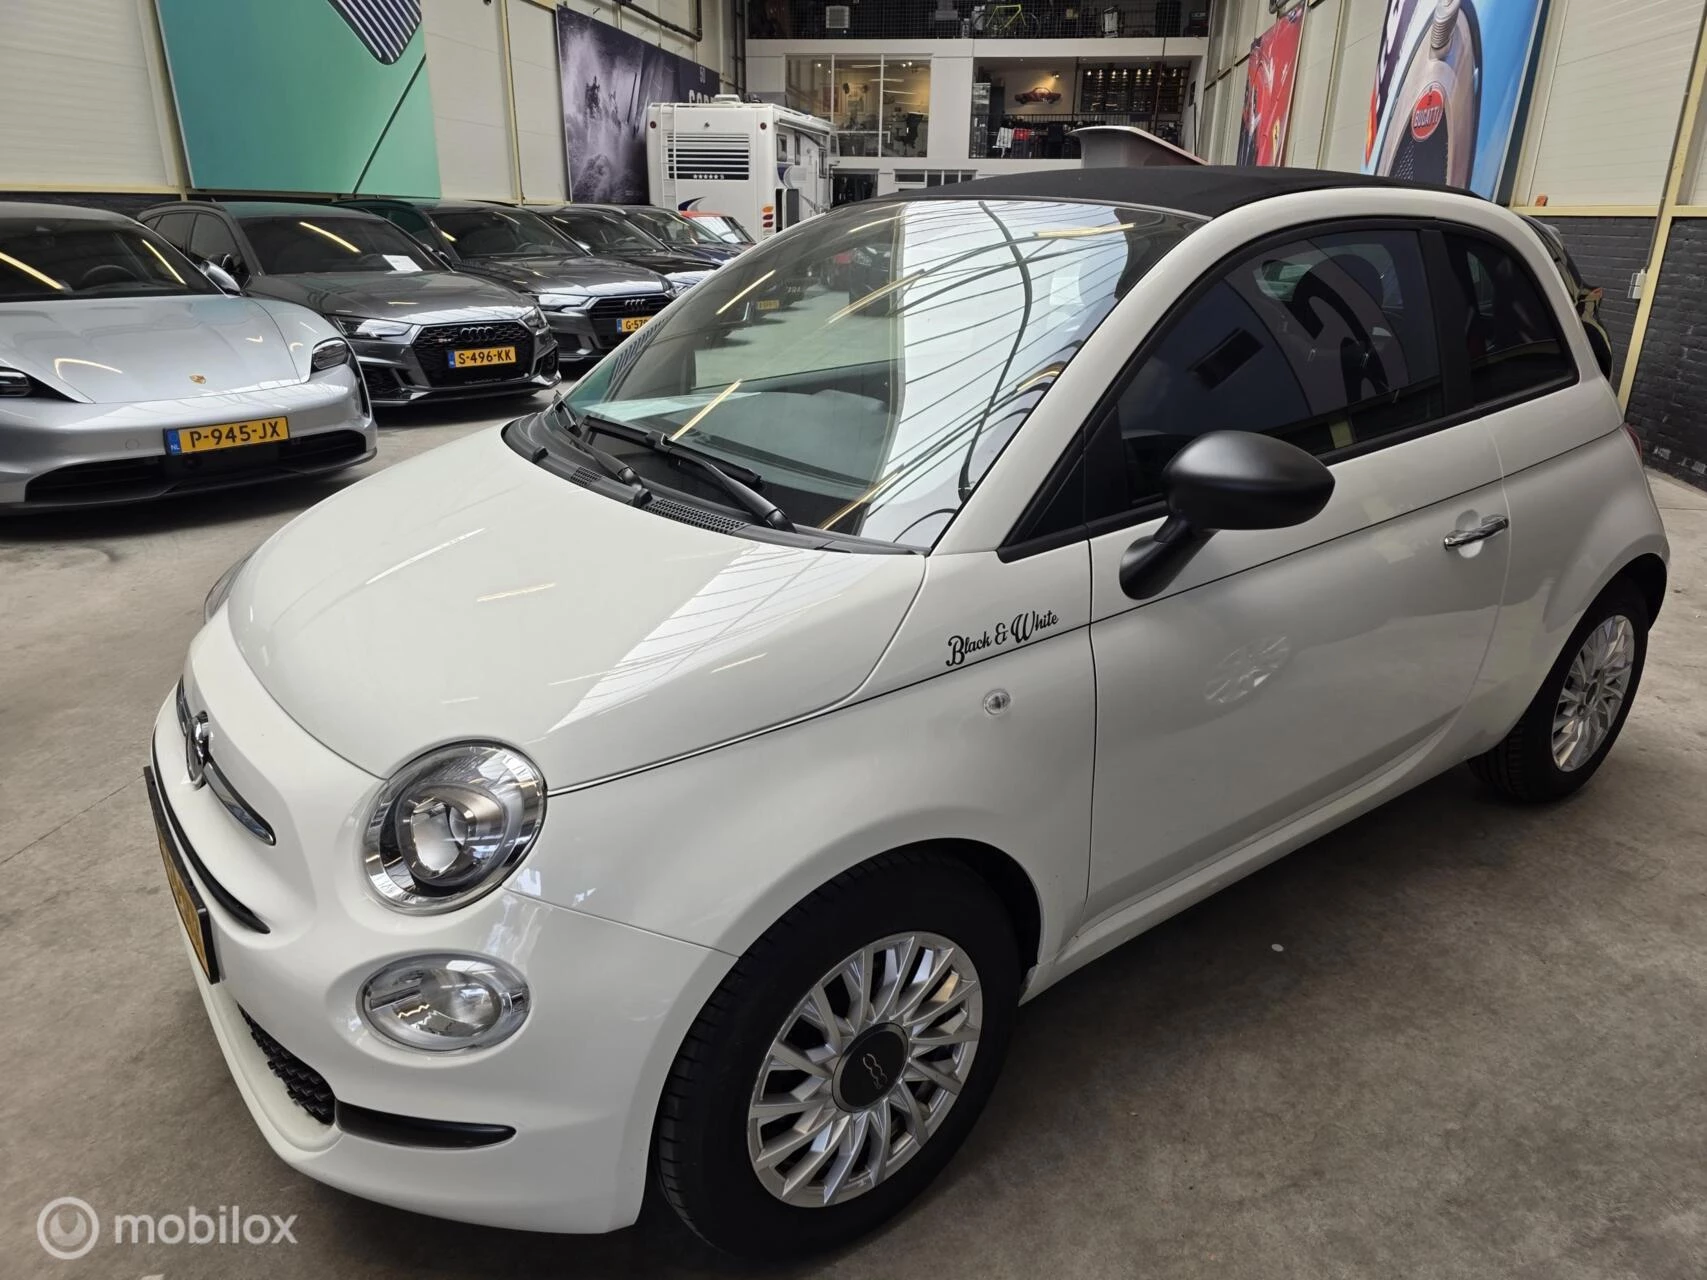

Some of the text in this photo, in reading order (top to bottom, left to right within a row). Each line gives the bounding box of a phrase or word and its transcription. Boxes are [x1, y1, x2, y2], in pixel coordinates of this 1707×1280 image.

[1413, 106, 1440, 128] BUGATTI
[458, 349, 512, 365] S-496-KK
[189, 420, 281, 449] P-945-JX
[945, 610, 1059, 666] Black & White
